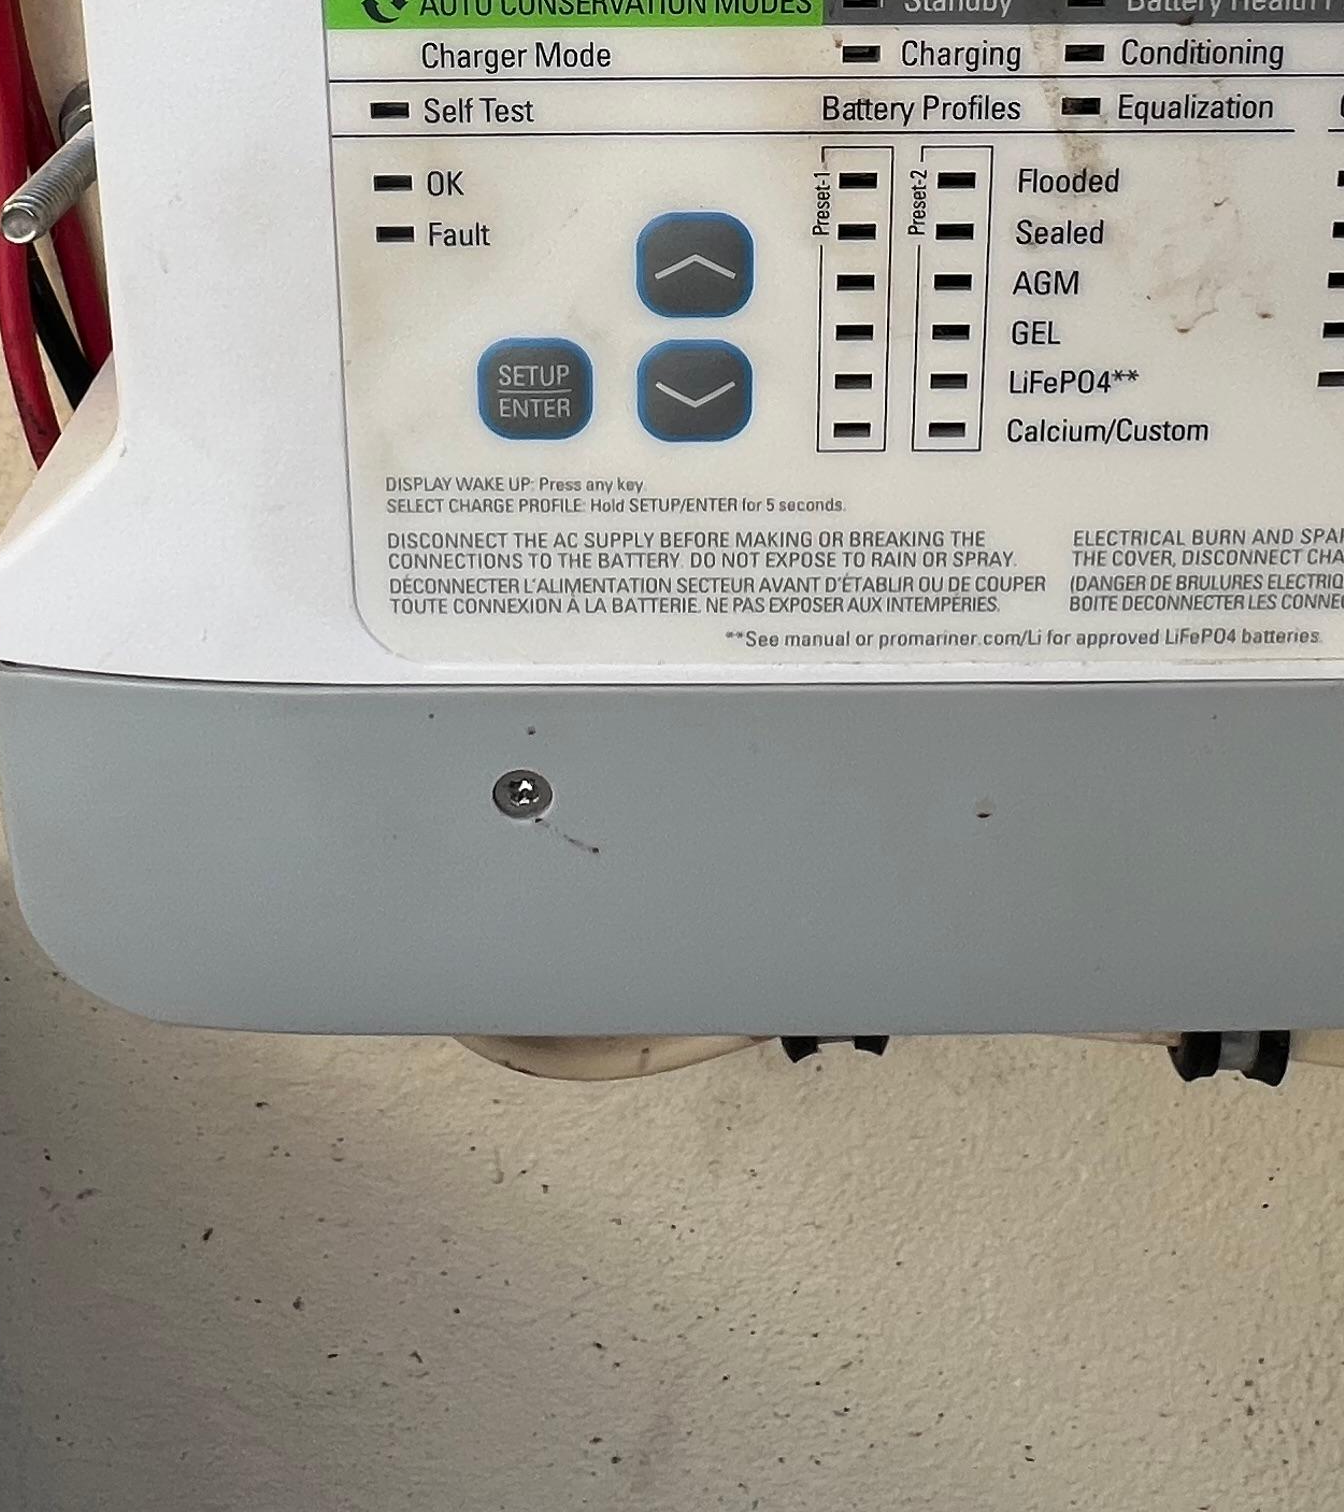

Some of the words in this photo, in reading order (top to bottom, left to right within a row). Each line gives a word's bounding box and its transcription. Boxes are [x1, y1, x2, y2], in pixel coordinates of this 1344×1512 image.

[422, 42, 528, 75] Charger
[535, 41, 611, 68] Mode
[901, 39, 1023, 73] Charging
[1121, 38, 1284, 71] Conditioning
[424, 97, 474, 124] Self
[478, 97, 535, 123] Test
[822, 95, 915, 127] Battery
[923, 94, 1021, 121] Profiles
[1118, 93, 1274, 126] Equalization
[427, 170, 465, 197] OK
[1018, 167, 1120, 194] Flooded
[812, 172, 831, 236] Preset-1
[907, 169, 928, 236] Preset-2
[428, 221, 491, 247] Fault
[1015, 219, 1104, 246] Sealed
[1012, 270, 1080, 296] AGM
[1011, 320, 1061, 346] GEL
[498, 364, 570, 387] SETUP
[499, 397, 571, 418] ENTER
[1007, 417, 1209, 445] Calcium/Custom
[385, 476, 453, 494] DISPLAY
[455, 476, 505, 492] WAKE
[539, 476, 583, 492] Press
[585, 480, 614, 495] any
[386, 498, 445, 514] SELECT
[448, 497, 515, 514] CHARGE
[590, 497, 626, 513] Hold
[628, 497, 738, 515] SETUP/ENTER
[741, 496, 763, 512] for
[766, 497, 775, 513] 5
[778, 497, 847, 513] seconds.
[387, 532, 509, 550] DISCONNECT
[512, 532, 548, 549] THE
[552, 531, 579, 549] AC
[583, 531, 655, 549] SUPPLY
[660, 531, 730, 549] BEFORE
[735, 530, 813, 549] MAKING
[818, 530, 844, 548] OR
[849, 530, 945, 548] BREAKING
[950, 530, 986, 548] THE
[1072, 529, 1187, 548] ELECTRICAL
[1191, 528, 1246, 547] BURN
[1251, 528, 1294, 546] AND
[388, 552, 524, 570] CONNECTIONS
[527, 552, 553, 570] TO
[556, 551, 593, 570] THE
[690, 551, 716, 569] DO
[721, 551, 761, 569] NOT
[765, 550, 837, 569] EXPOSE
[841, 551, 866, 569] TO
[871, 550, 917, 568] RAIN
[922, 551, 948, 568] OR
[1071, 549, 1108, 568] THE
[1111, 549, 1177, 569] COVER,
[1181, 547, 1305, 566] DISCONNECT
